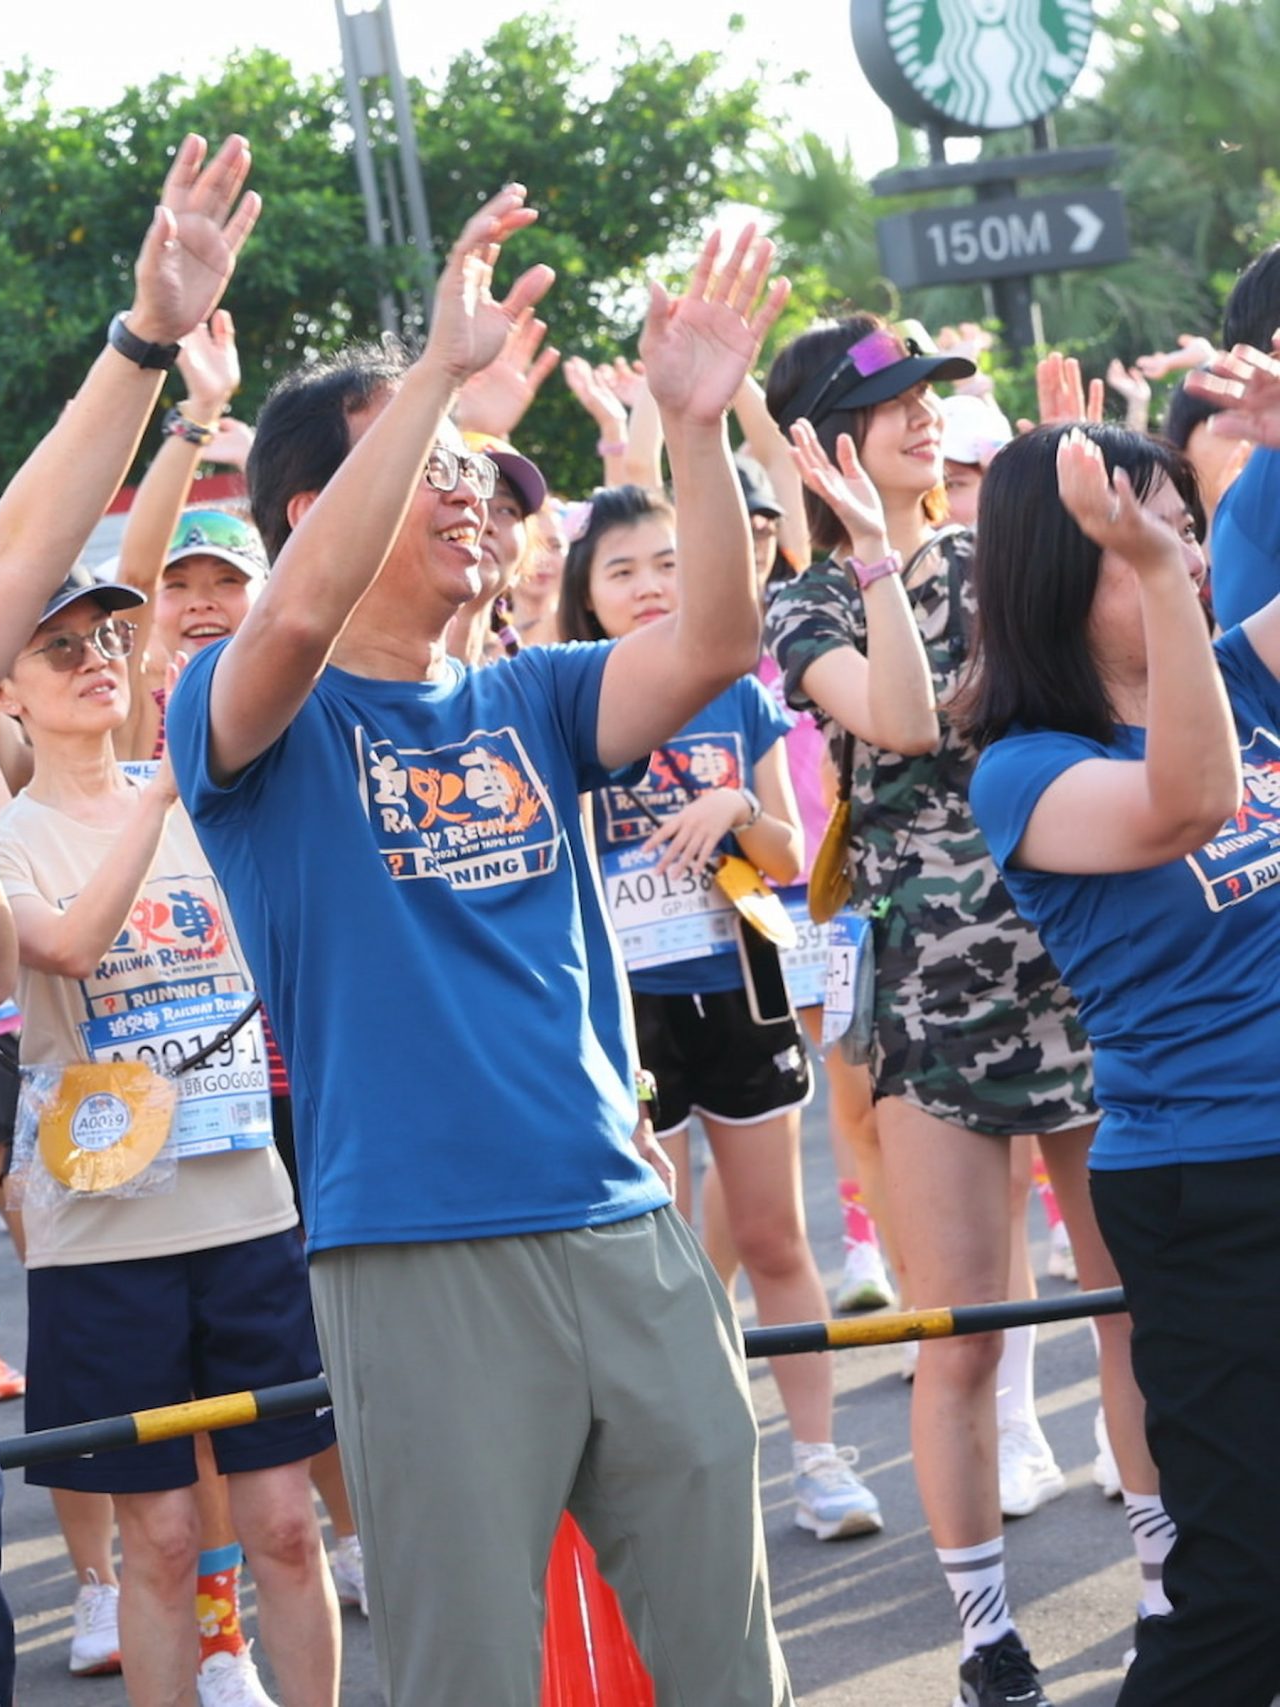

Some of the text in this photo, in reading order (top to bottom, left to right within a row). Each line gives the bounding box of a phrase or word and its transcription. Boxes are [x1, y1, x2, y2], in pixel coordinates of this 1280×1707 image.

[926, 209, 1051, 267] 150M
[444, 815, 506, 847] RELAY
[161, 1000, 214, 1022] RAILWAY
[179, 1071, 264, 1097] 頭GOGOGO
